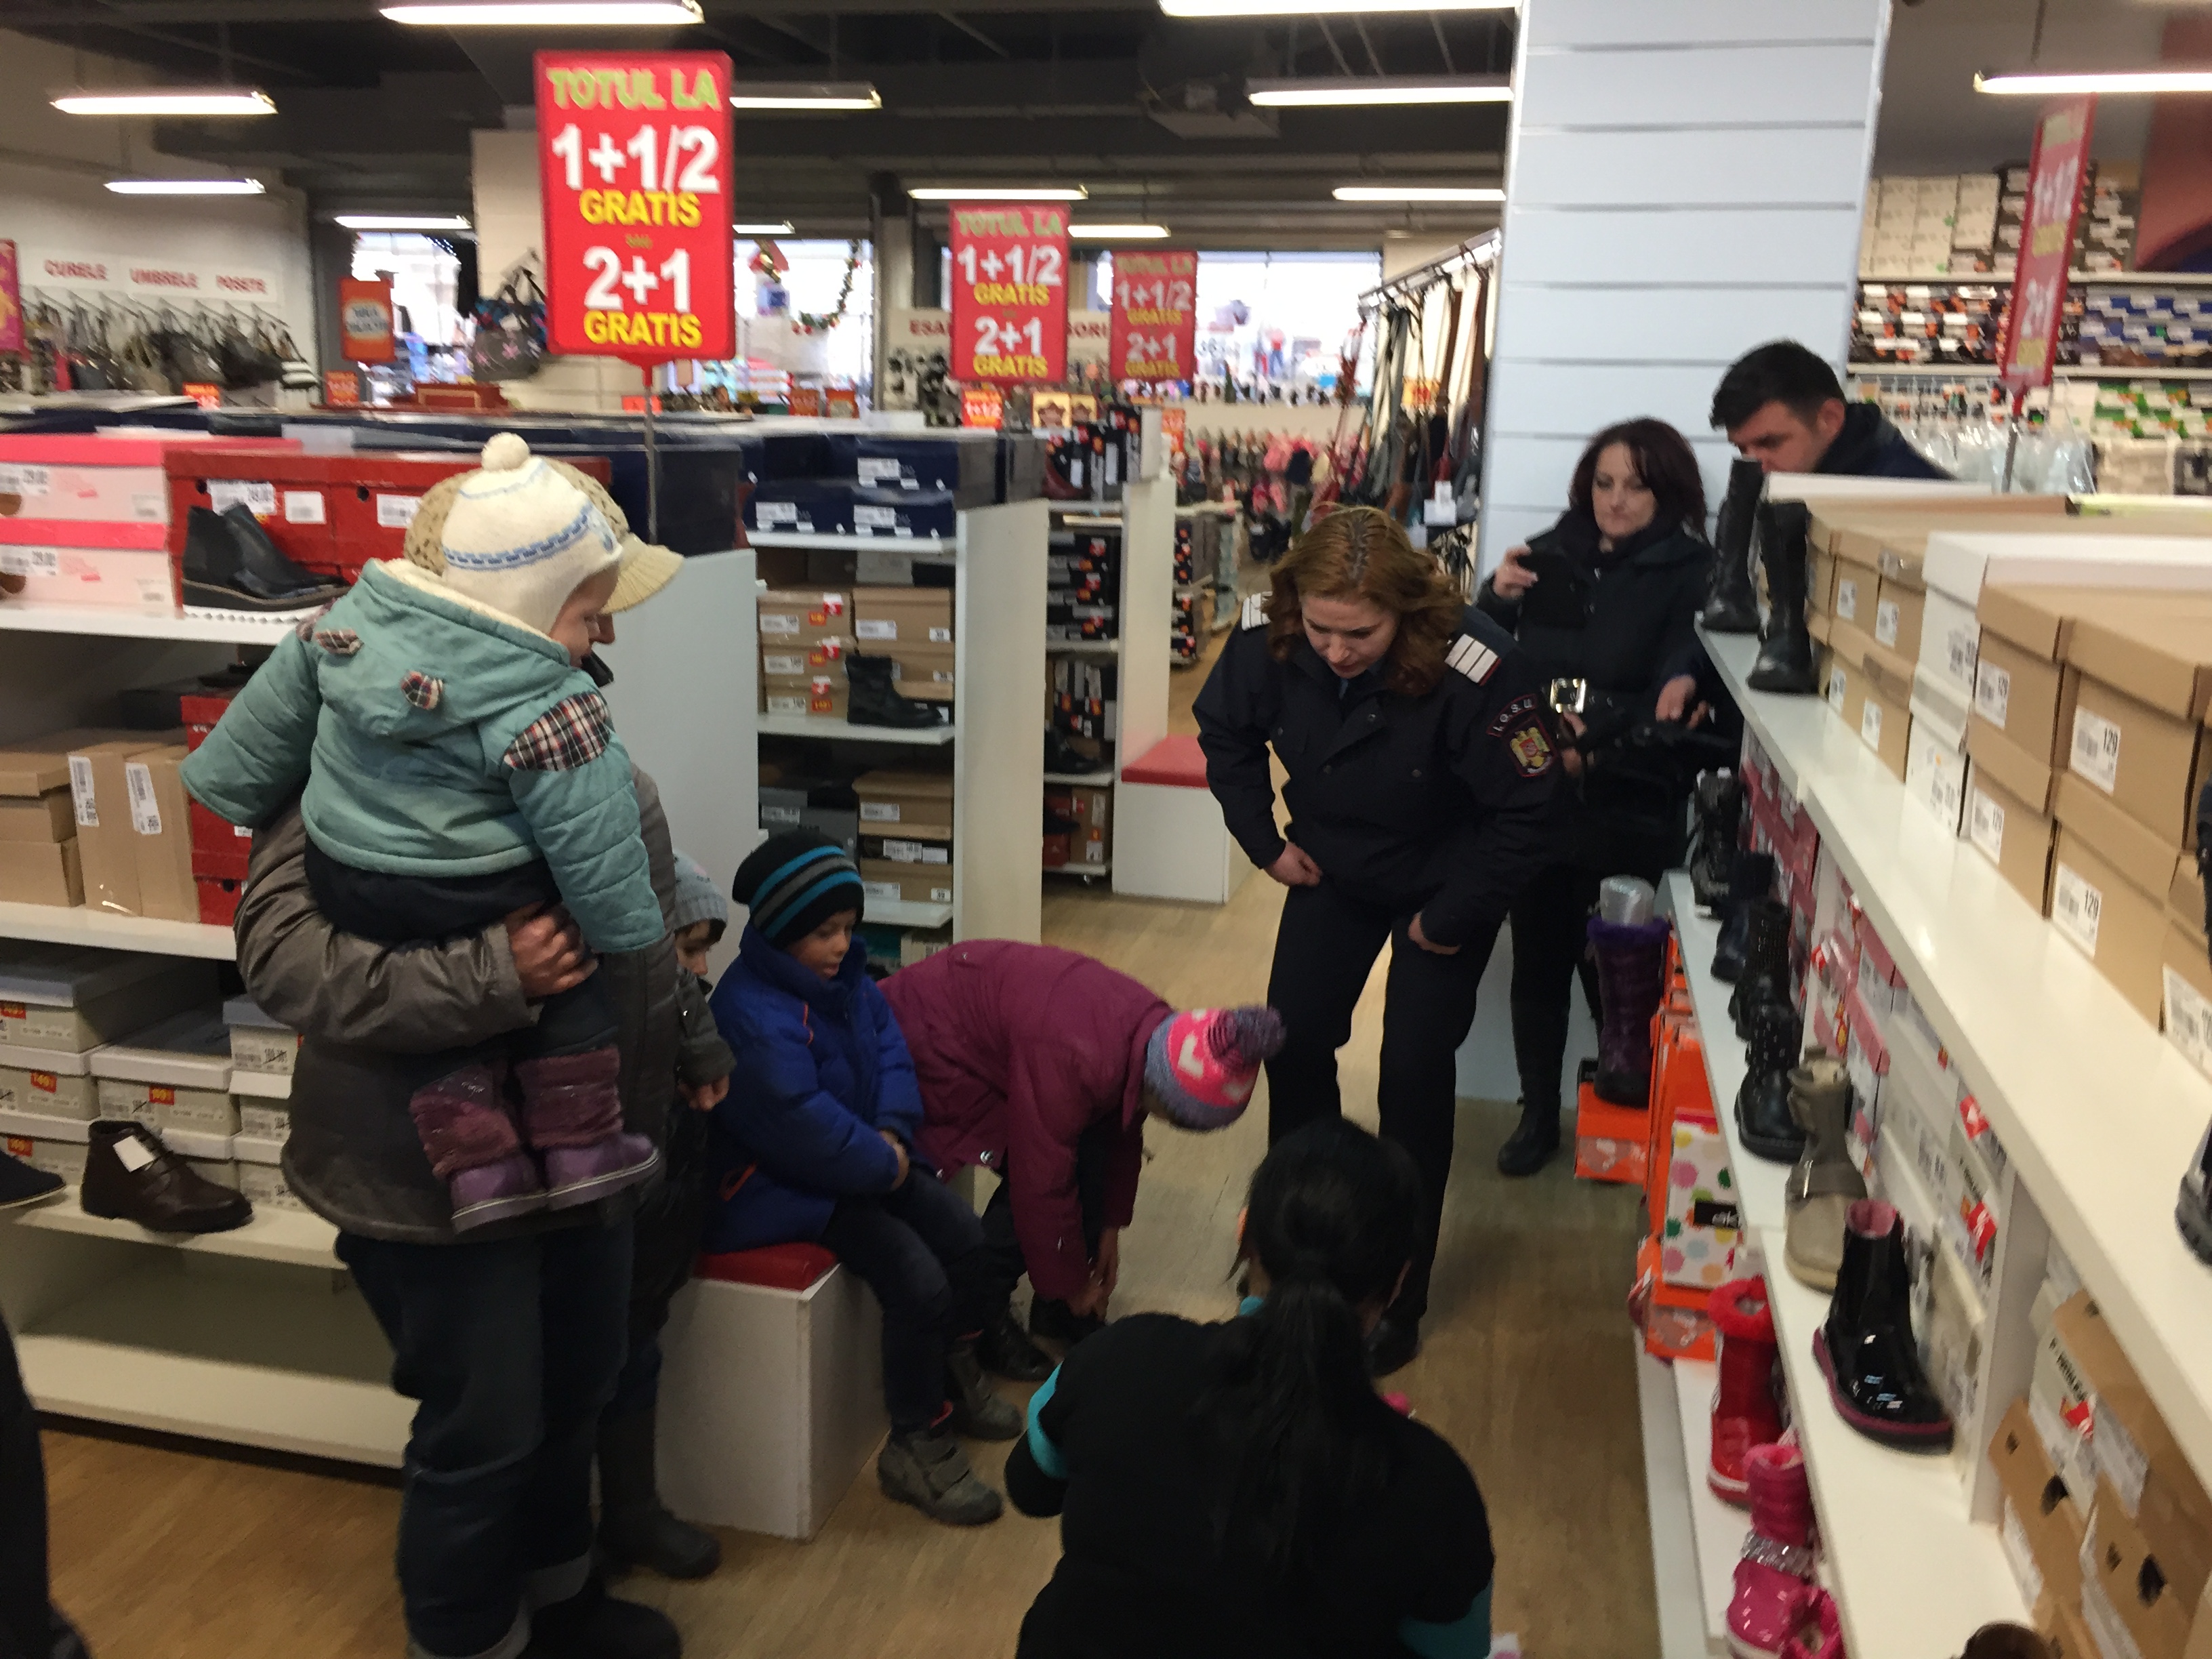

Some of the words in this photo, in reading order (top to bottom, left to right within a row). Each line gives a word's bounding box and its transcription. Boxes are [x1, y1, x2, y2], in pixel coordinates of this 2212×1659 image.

[546, 68, 667, 110] TOTUL
[671, 68, 722, 112] LA
[551, 123, 720, 192] 1+1/2
[579, 188, 702, 228] GRATIS
[955, 211, 1029, 238] TOTUL
[1033, 212, 1064, 238] LA
[583, 245, 691, 314] 2+1
[957, 243, 1062, 287] 1+1/2
[973, 281, 1050, 307] GRATIS
[1115, 279, 1193, 311] 1+1/2
[583, 309, 702, 349] GRATIS
[909, 319, 946, 336] ESA
[974, 315, 1042, 358] 2+1
[1127, 332, 1176, 363] 2+1
[973, 354, 1048, 378] GRATIS
